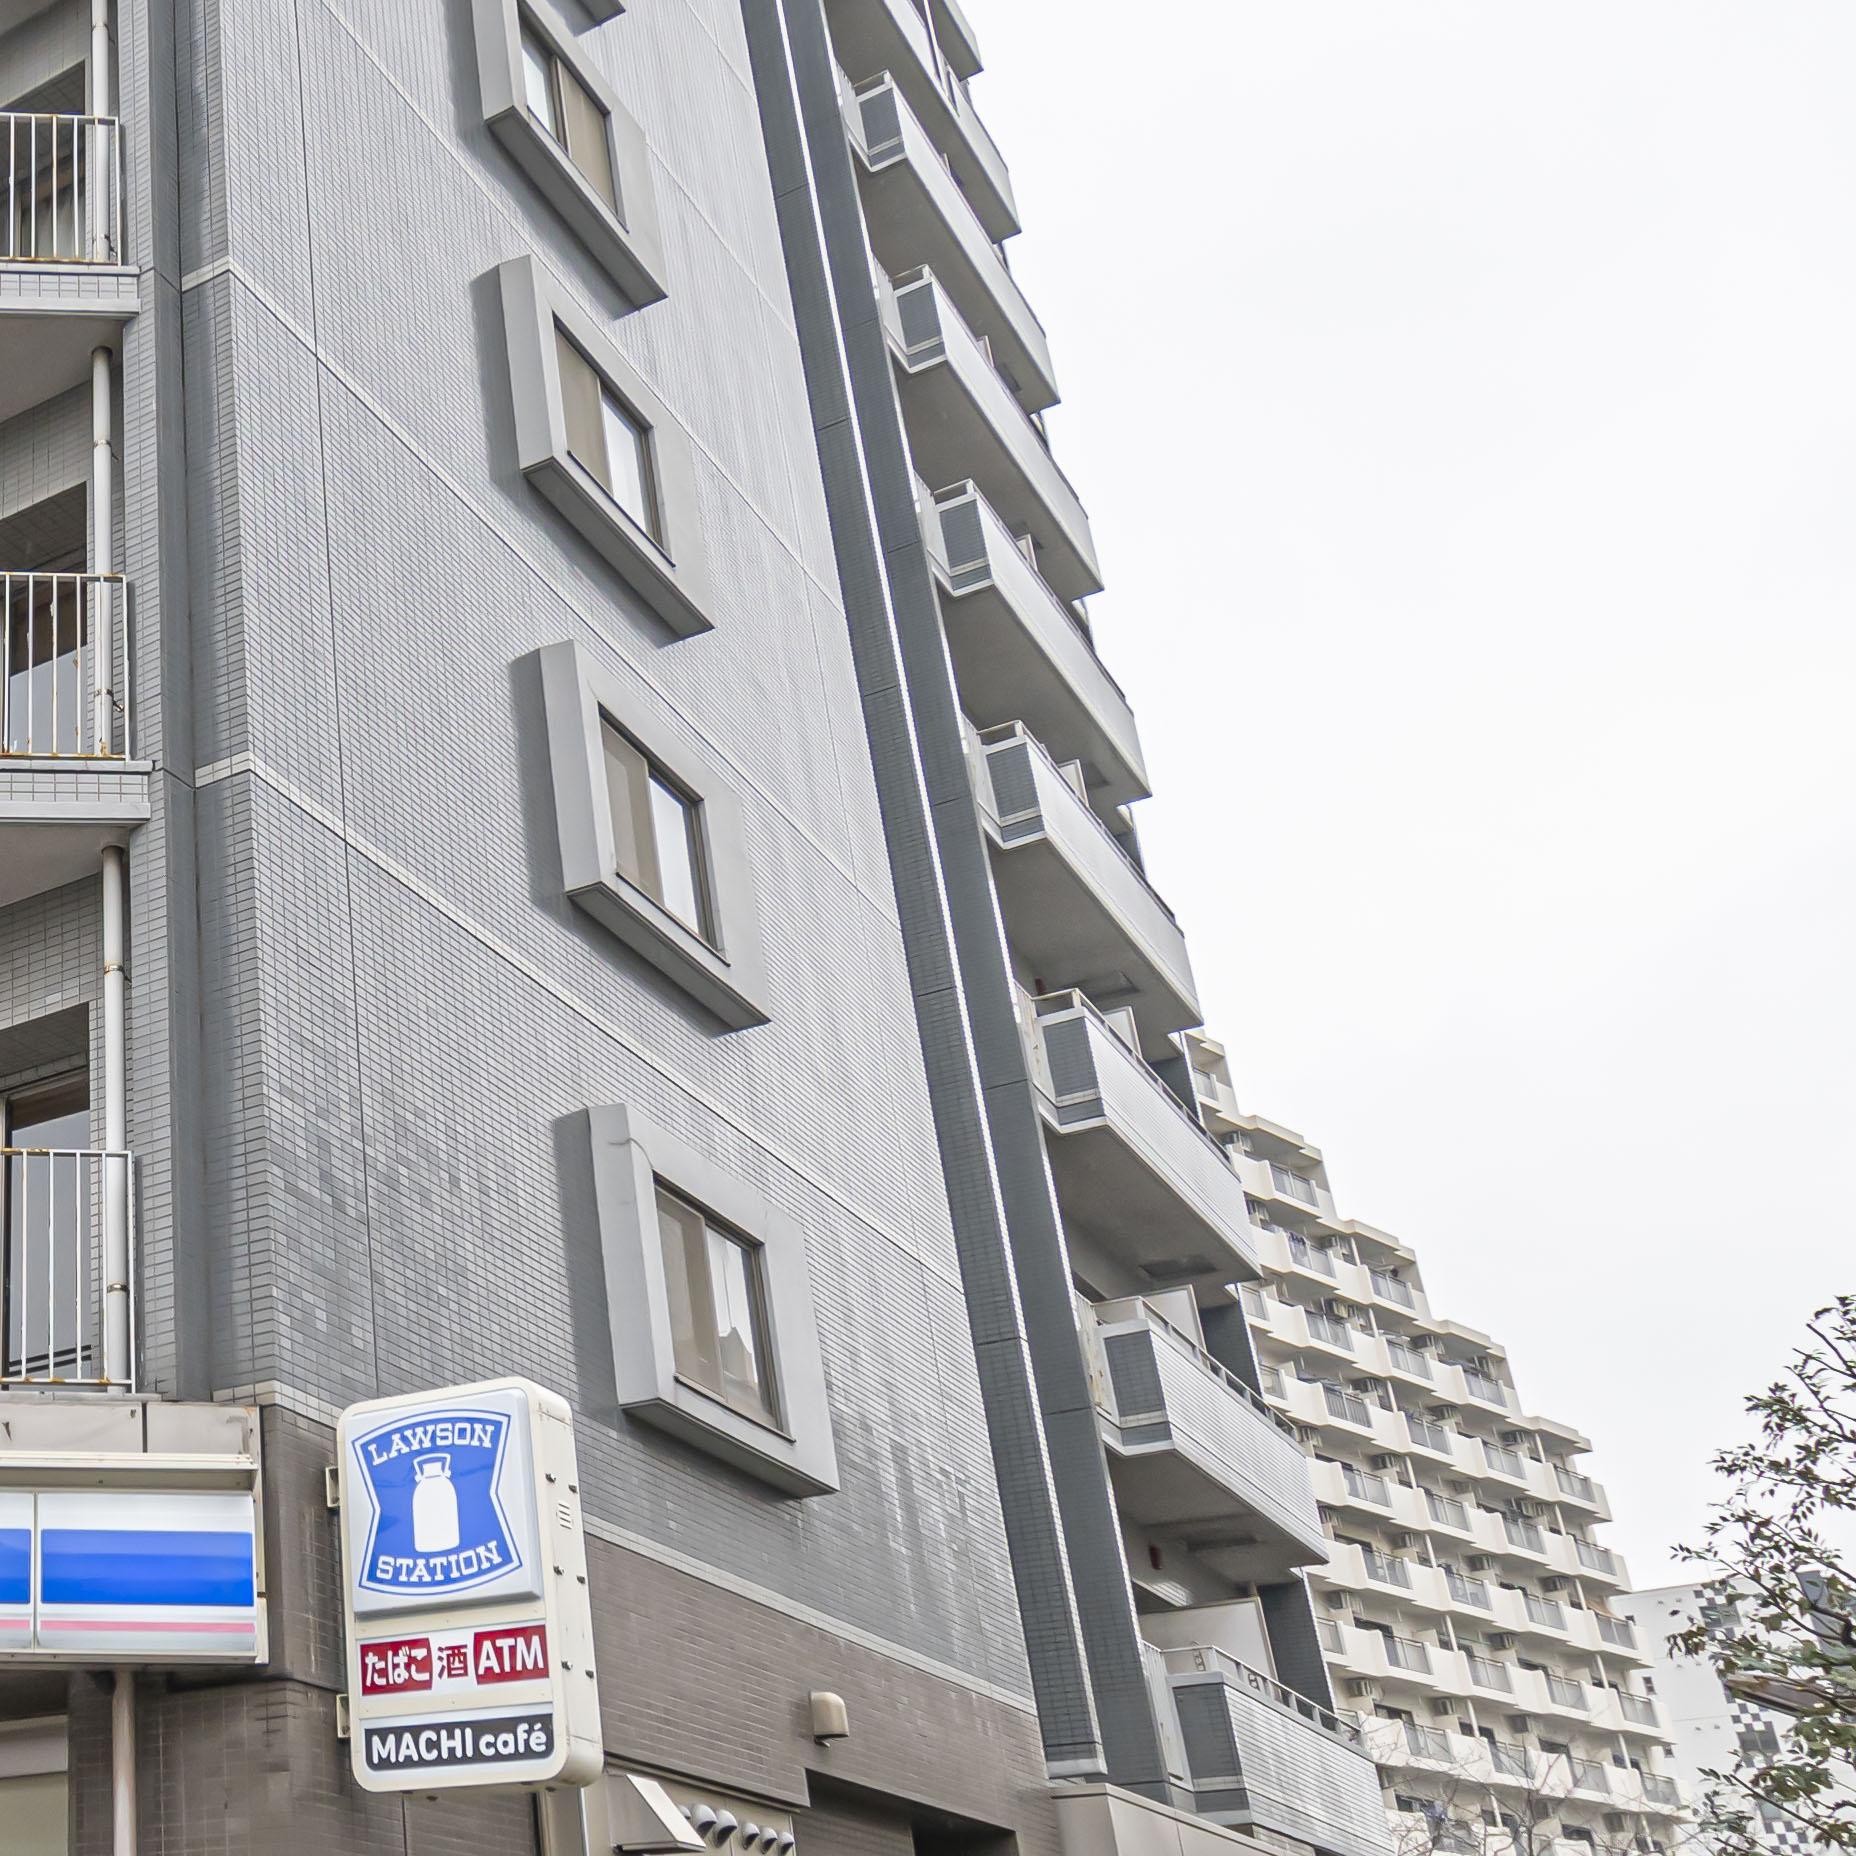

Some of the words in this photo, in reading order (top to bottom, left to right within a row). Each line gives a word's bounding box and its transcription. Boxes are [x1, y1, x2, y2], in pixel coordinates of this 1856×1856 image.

[367, 1422, 495, 1466] LAWSON
[376, 1541, 503, 1583] STATION
[364, 1647, 431, 1687] たばこ
[437, 1644, 469, 1680] 酒
[477, 1636, 544, 1675] ATM
[370, 1728, 474, 1764] MACHI
[483, 1722, 547, 1756] café
